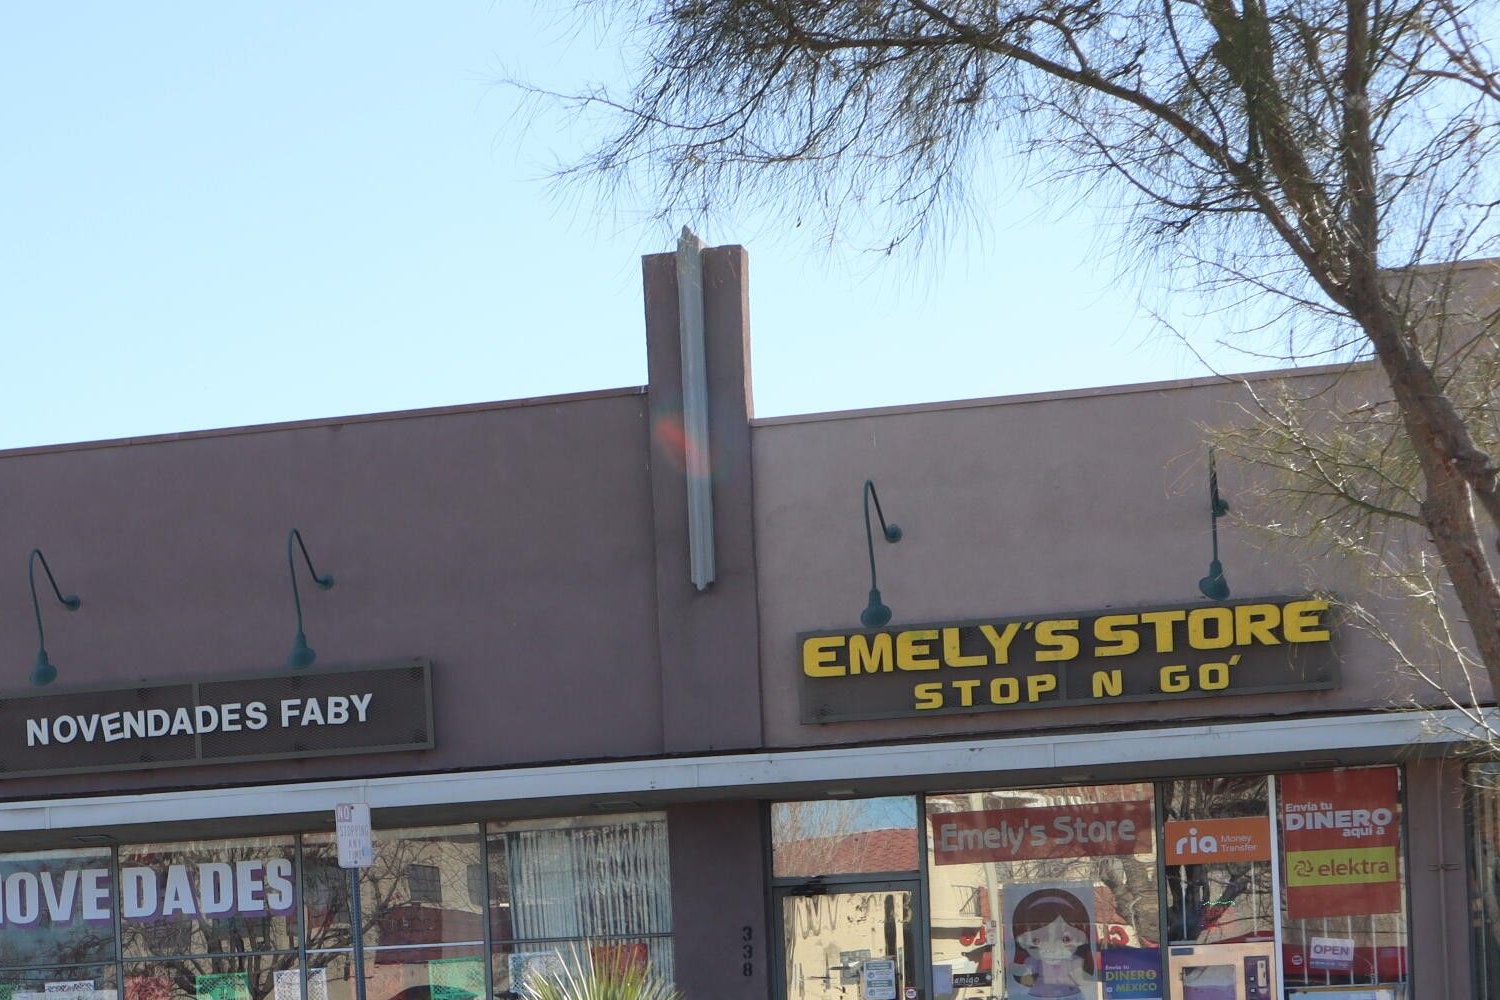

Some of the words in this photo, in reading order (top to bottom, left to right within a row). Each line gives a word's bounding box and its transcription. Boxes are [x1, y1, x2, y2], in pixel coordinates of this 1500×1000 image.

[803, 619, 1080, 678] EMELY'S
[1094, 600, 1332, 658] STORE
[914, 674, 1057, 710] STOP
[1092, 671, 1123, 698] N
[26, 701, 269, 747] NOVENDADES
[280, 693, 374, 728] FABY
[1320, 802, 1333, 810] tu
[1285, 808, 1393, 831] DINERO
[940, 818, 1048, 855] Emely's
[1053, 816, 1136, 845] Store
[1221, 834, 1252, 844] Money
[1376, 826, 1385, 835] a
[1176, 827, 1218, 855] ria
[1221, 844, 1257, 853] Transfer
[1318, 858, 1389, 877] elektra
[742, 926, 753, 977] 338
[1313, 944, 1350, 956] OPEN
[954, 974, 980, 987] amigo
[1105, 969, 1157, 982] DINERO
